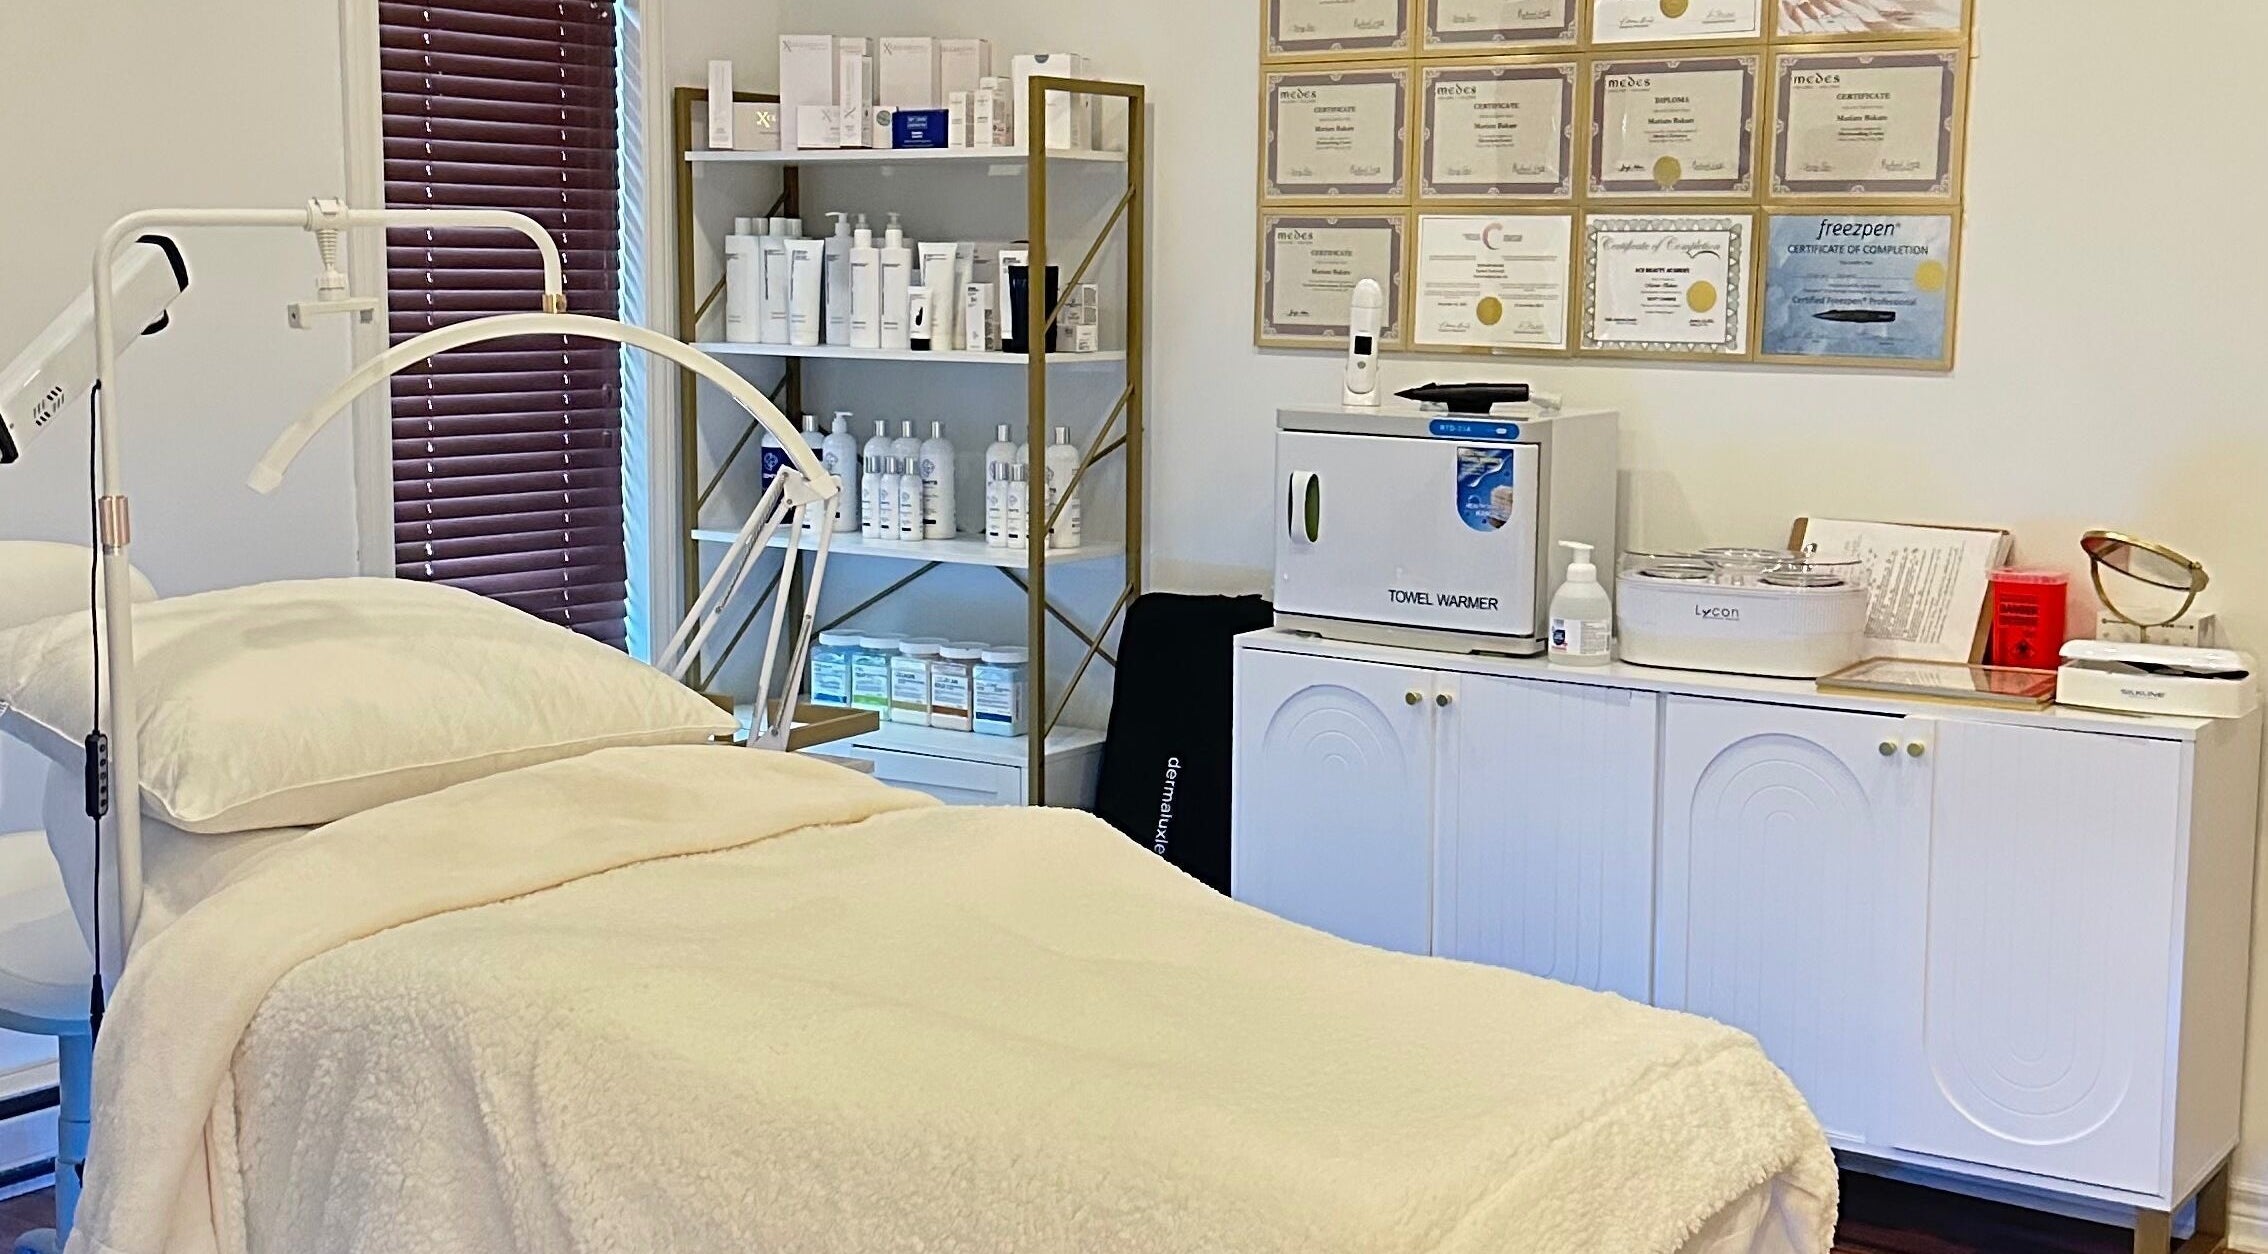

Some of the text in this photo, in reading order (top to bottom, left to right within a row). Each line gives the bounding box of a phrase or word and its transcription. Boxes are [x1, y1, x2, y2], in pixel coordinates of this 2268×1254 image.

[1608, 76, 1651, 88] medes
[1793, 73, 1840, 85] medes
[1280, 88, 1317, 99] medes
[1437, 84, 1477, 95] medes
[1277, 230, 1314, 241] medes
[1310, 249, 1353, 257] CERTIFICATE
[1787, 244, 1929, 255] CERTIFICATE OF COMPLETION
[1388, 589, 1499, 611] TOWEL WARMER
[1695, 604, 1740, 618] Lycon
